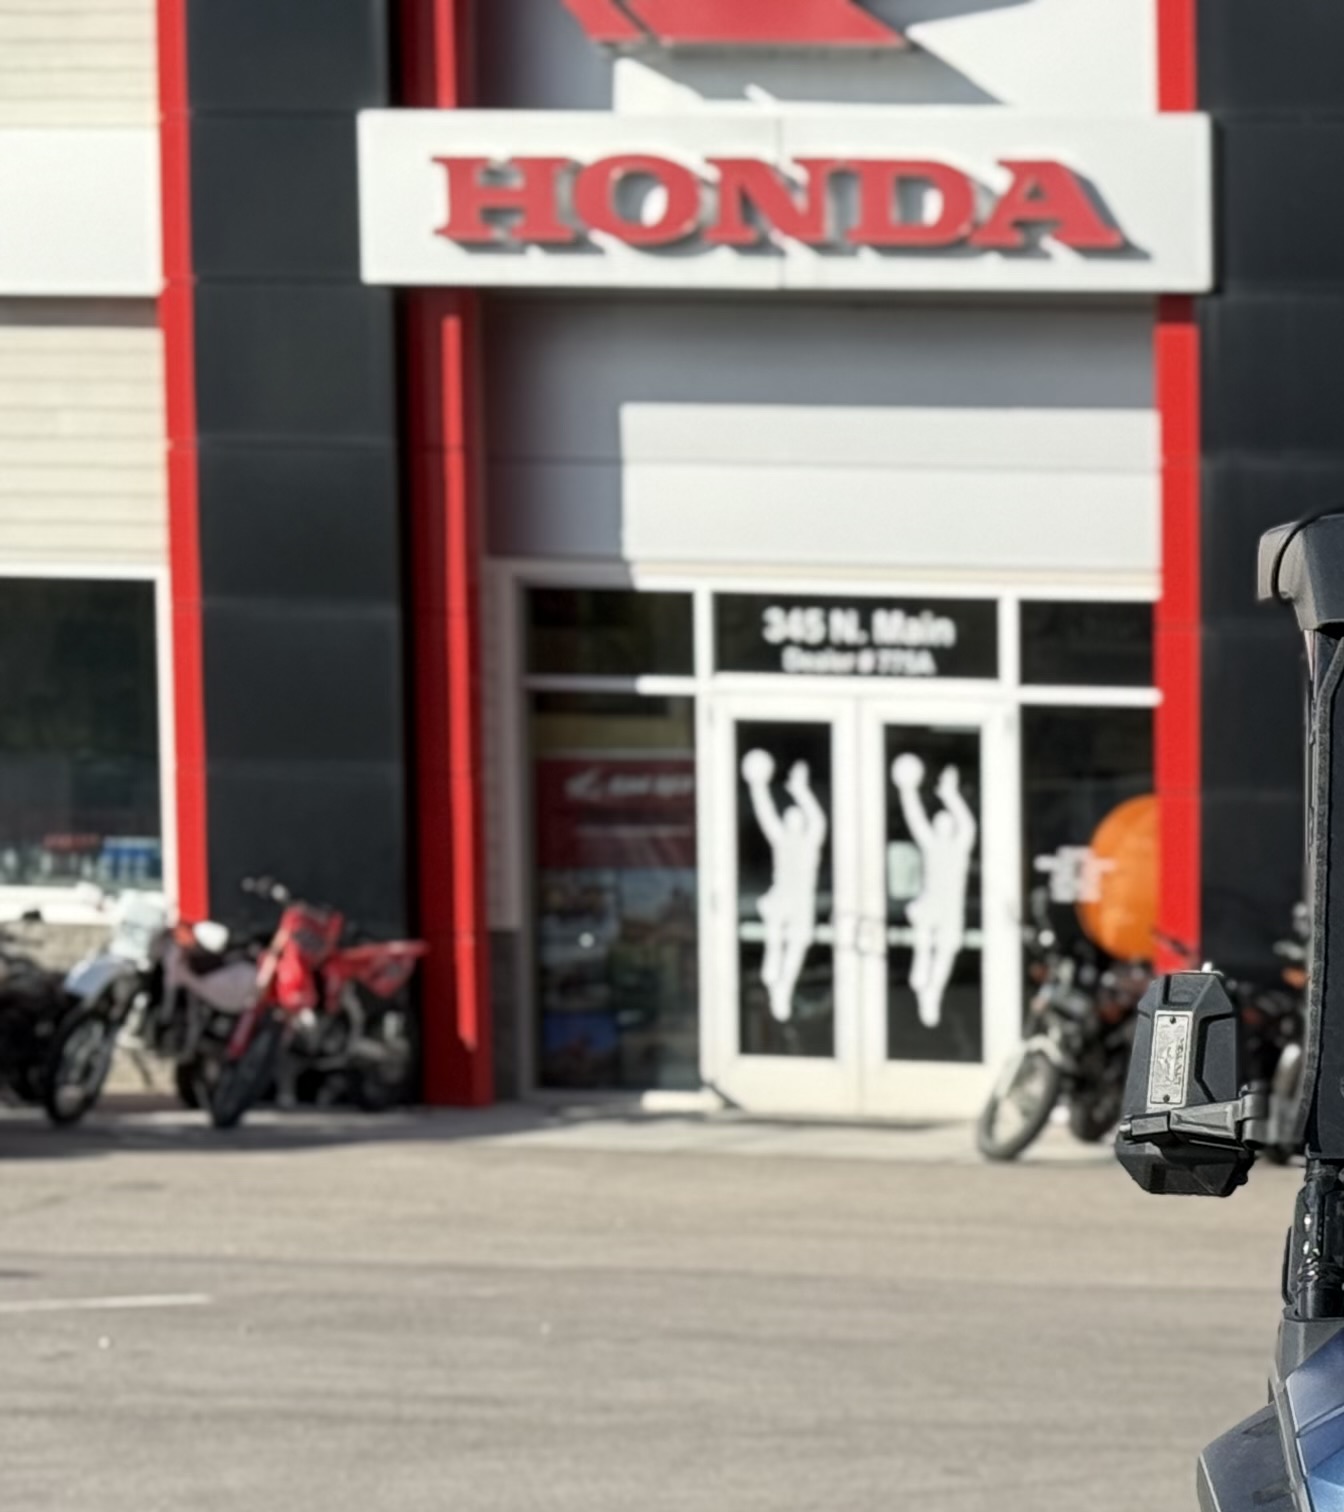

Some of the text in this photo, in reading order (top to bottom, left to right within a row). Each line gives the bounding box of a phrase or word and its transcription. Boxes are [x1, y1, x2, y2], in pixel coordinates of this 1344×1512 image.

[432, 154, 1125, 248] HONDA
[762, 606, 957, 648] 345 N. Main
[782, 646, 855, 673] Dealer
